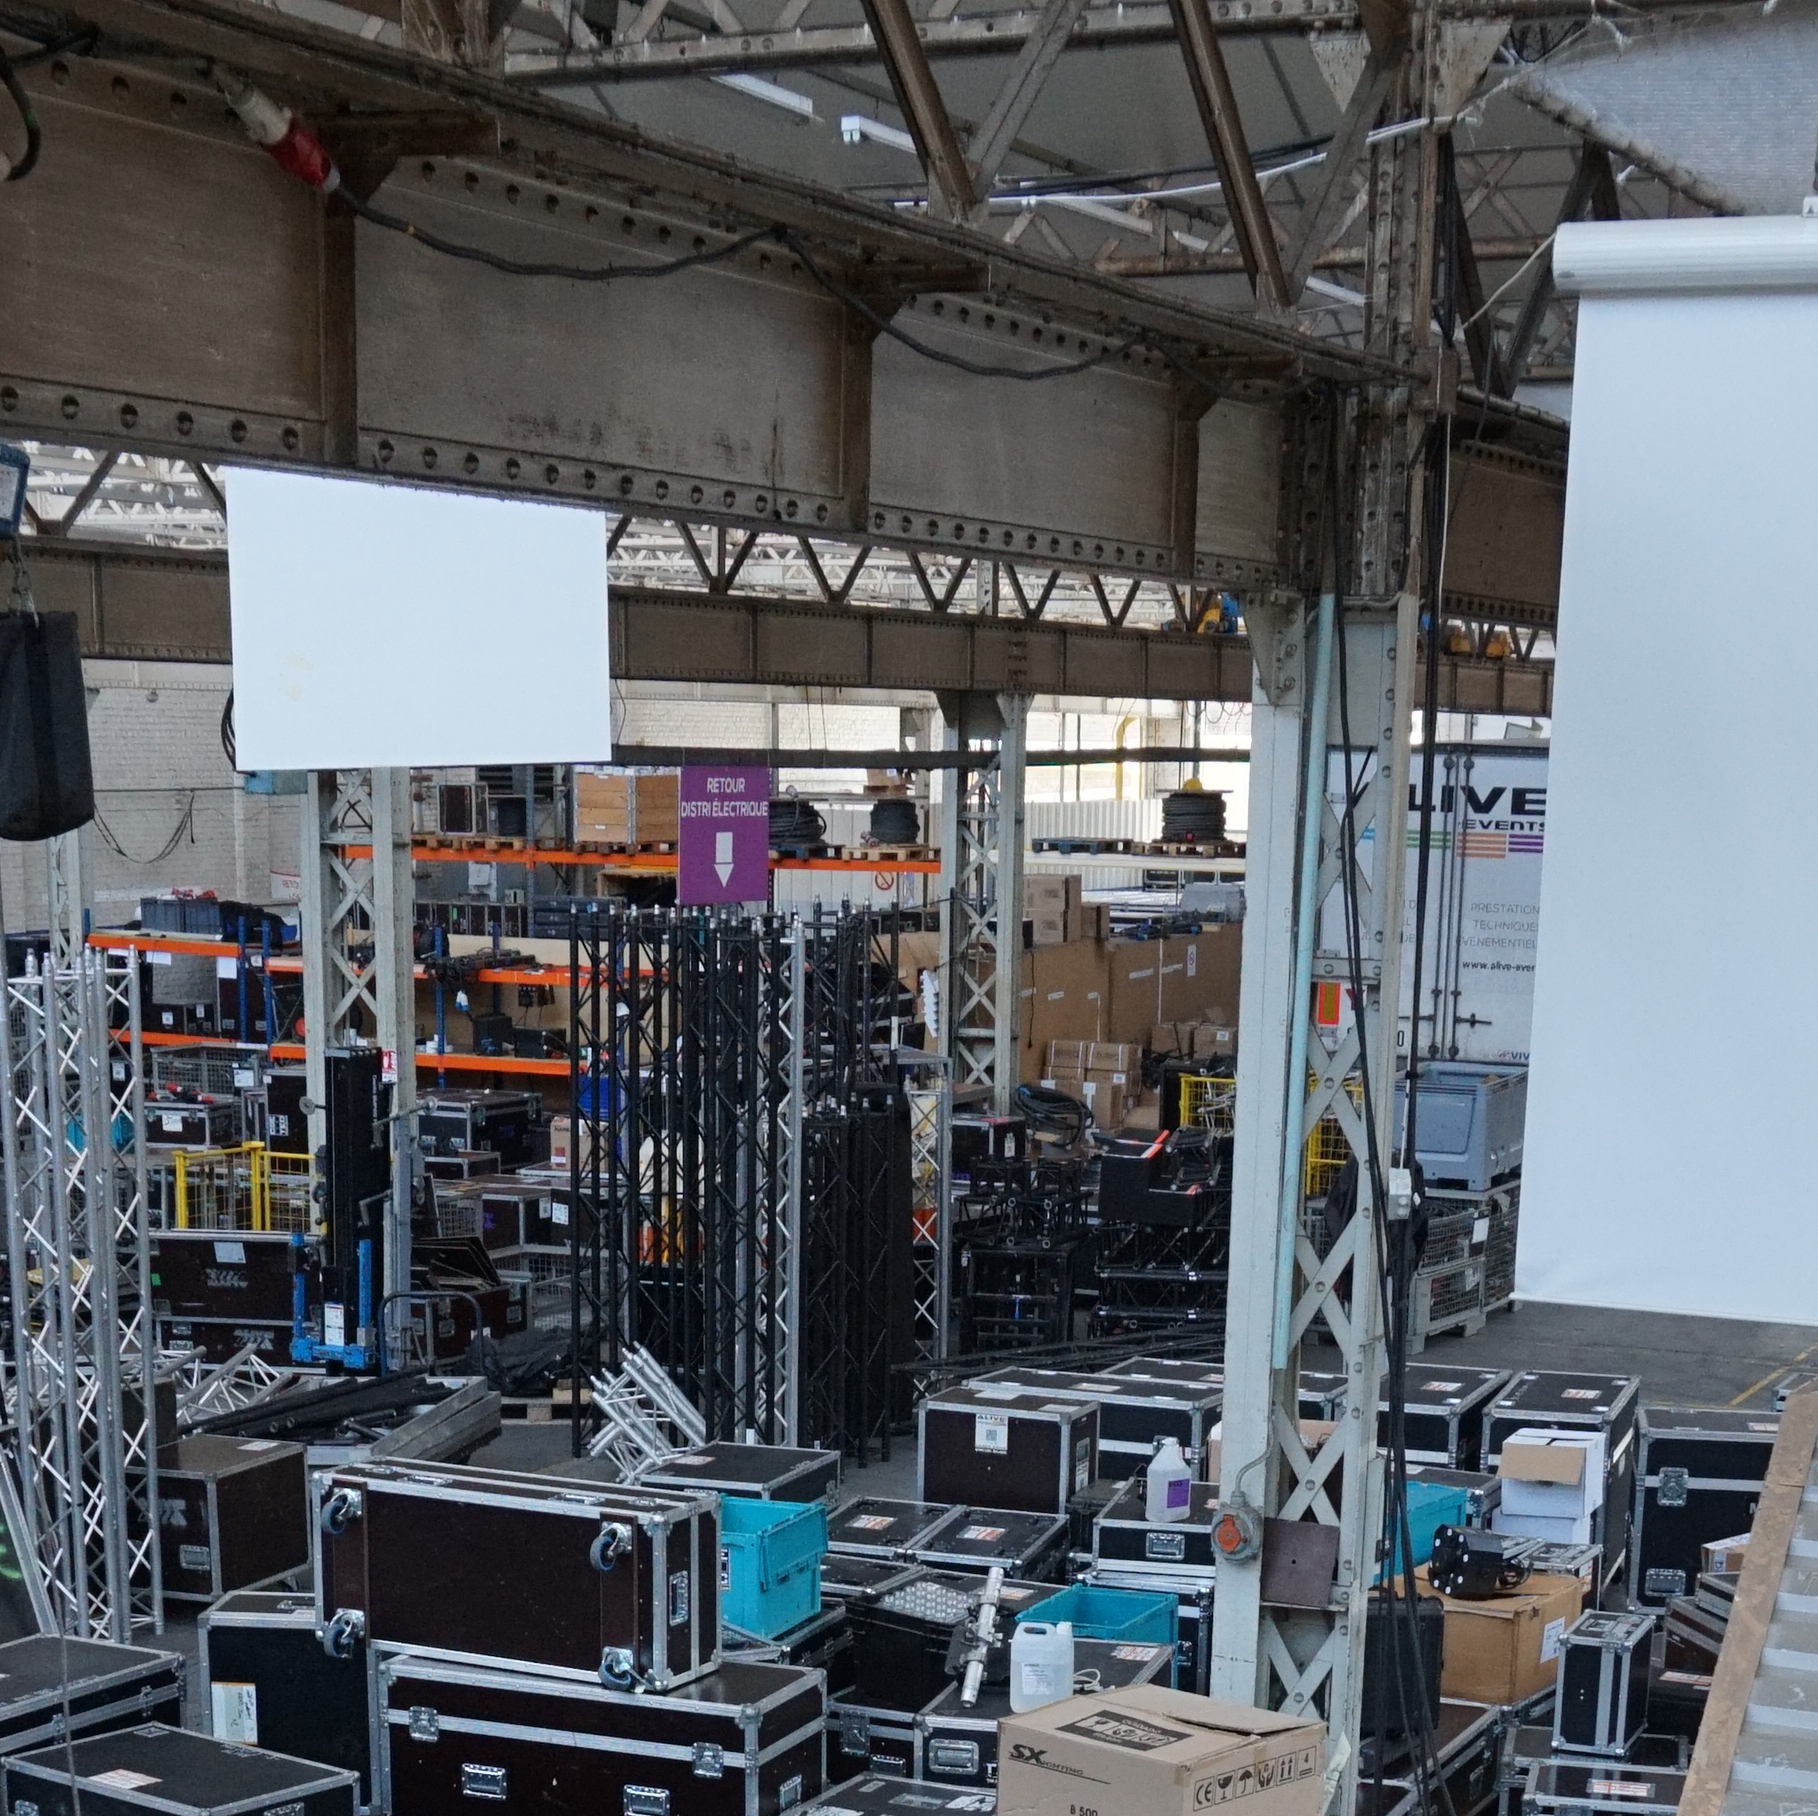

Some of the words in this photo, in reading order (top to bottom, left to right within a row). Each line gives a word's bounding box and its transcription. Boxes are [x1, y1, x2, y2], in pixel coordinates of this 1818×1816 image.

[706, 777, 746, 794] RETOUR
[681, 801, 711, 817] DISTRI
[712, 798, 769, 817] ÉLECTRIQUE
[1408, 783, 1547, 816] LIVE
[1070, 1804, 1077, 1815] B
